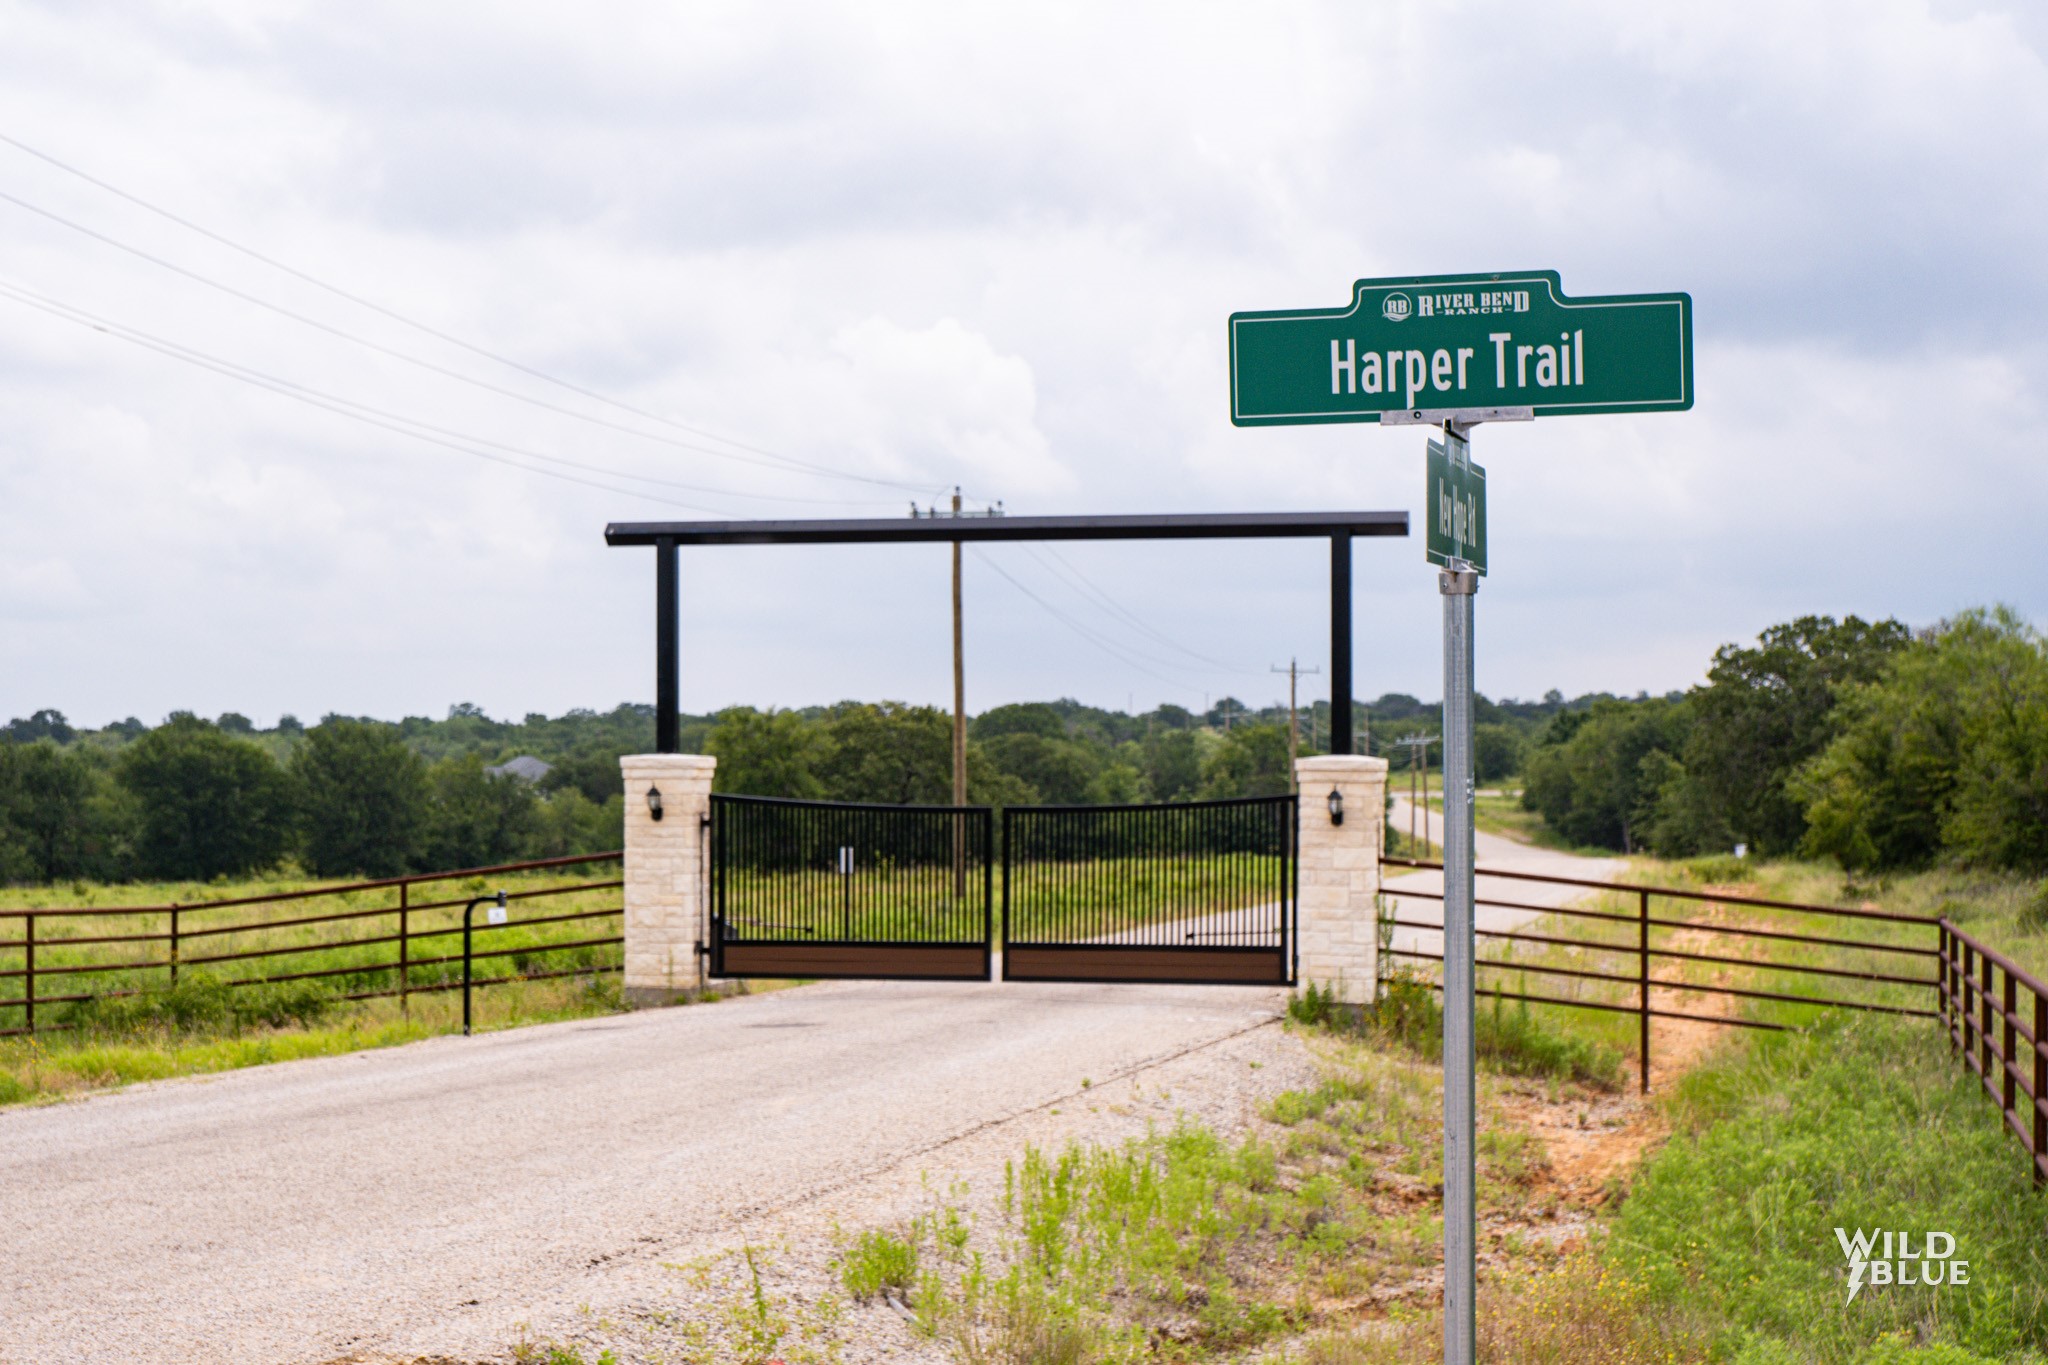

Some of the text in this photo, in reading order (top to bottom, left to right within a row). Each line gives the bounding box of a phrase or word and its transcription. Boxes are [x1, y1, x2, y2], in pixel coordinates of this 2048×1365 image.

[1387, 299, 1408, 314] RB
[1417, 290, 1530, 317] RIVER BEND
[1444, 306, 1503, 316] RANCH
[1329, 329, 1585, 410] Harper Trail
[1439, 477, 1477, 558] New Hope Rd
